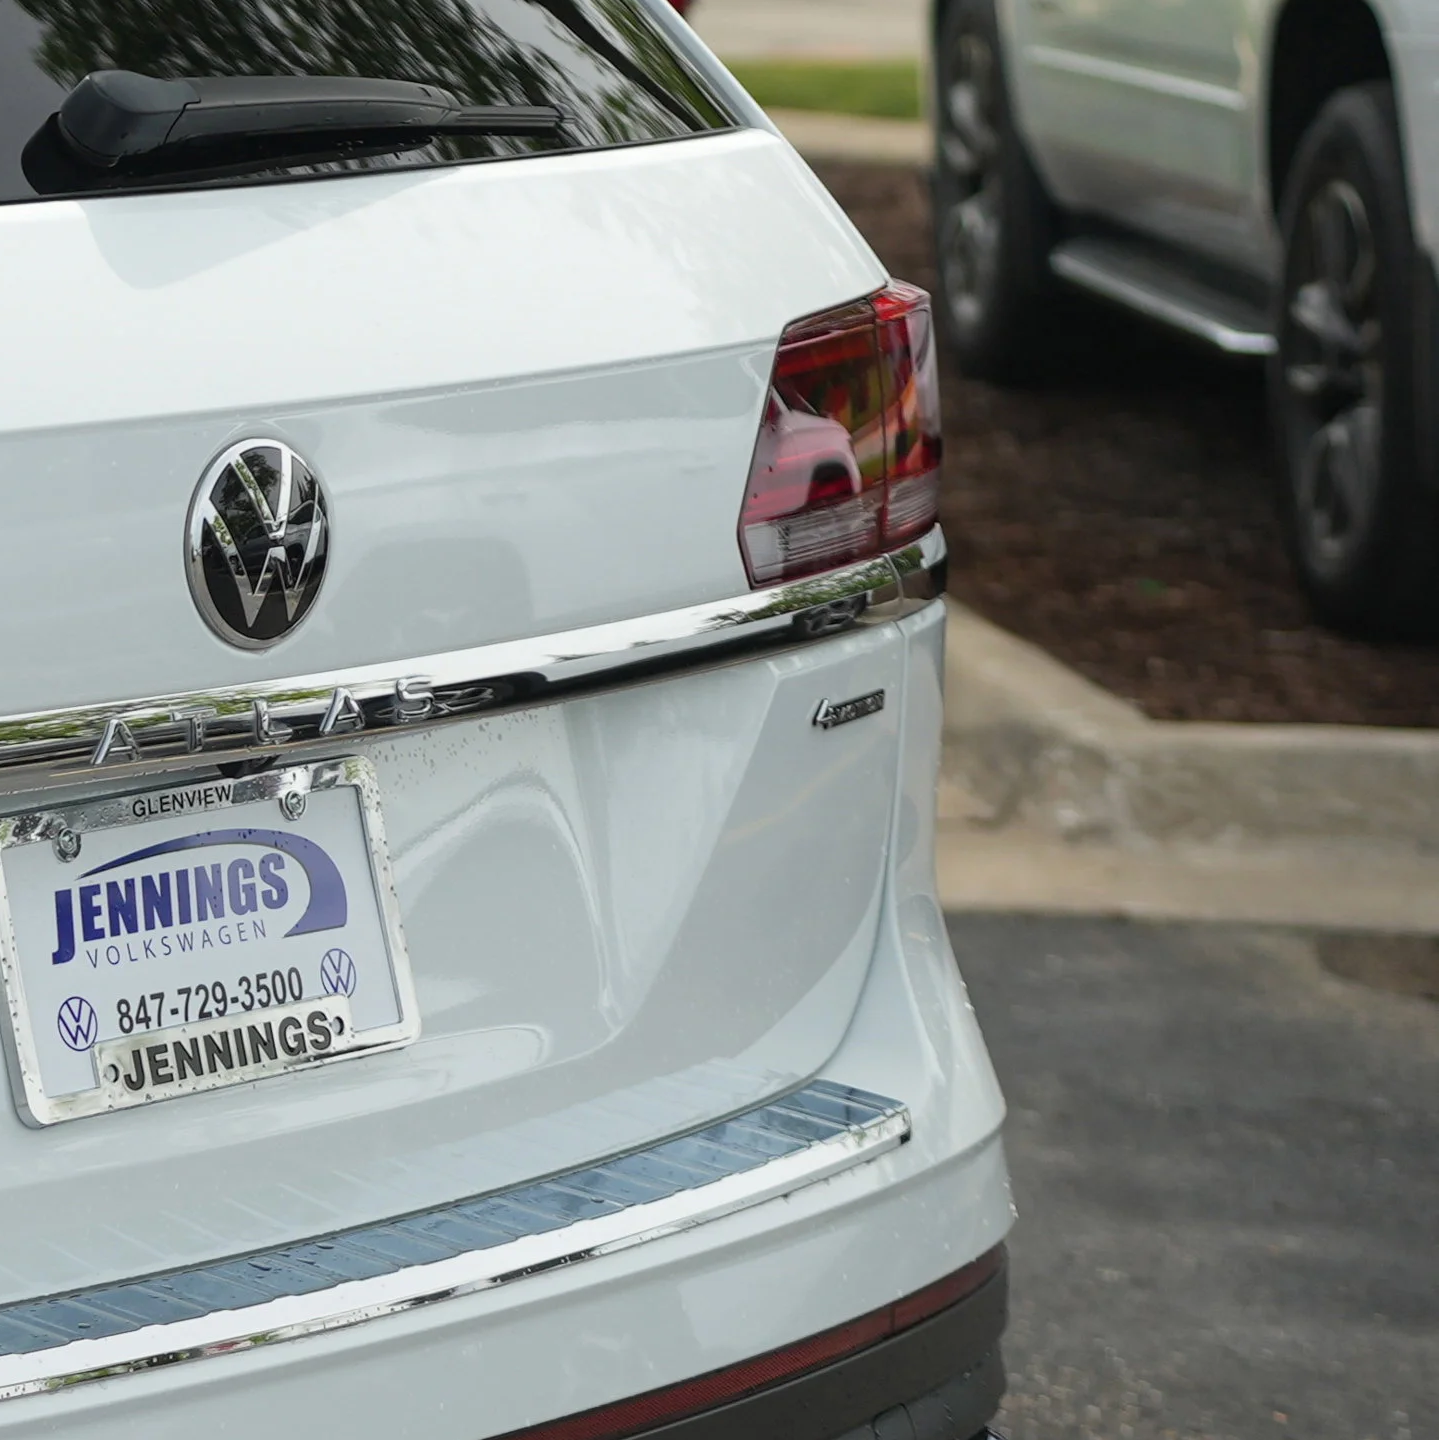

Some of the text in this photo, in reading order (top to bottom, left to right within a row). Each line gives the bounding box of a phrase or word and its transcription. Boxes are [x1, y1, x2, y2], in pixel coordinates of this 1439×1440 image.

[91, 675, 434, 764] ATLAS
[132, 784, 232, 817] GLENVIEW
[51, 852, 288, 965] JENNINGS
[86, 919, 266, 969] VOLKSWAGEN
[116, 966, 303, 1034] 847-729-3500
[123, 1009, 332, 1091] JENNINGS
